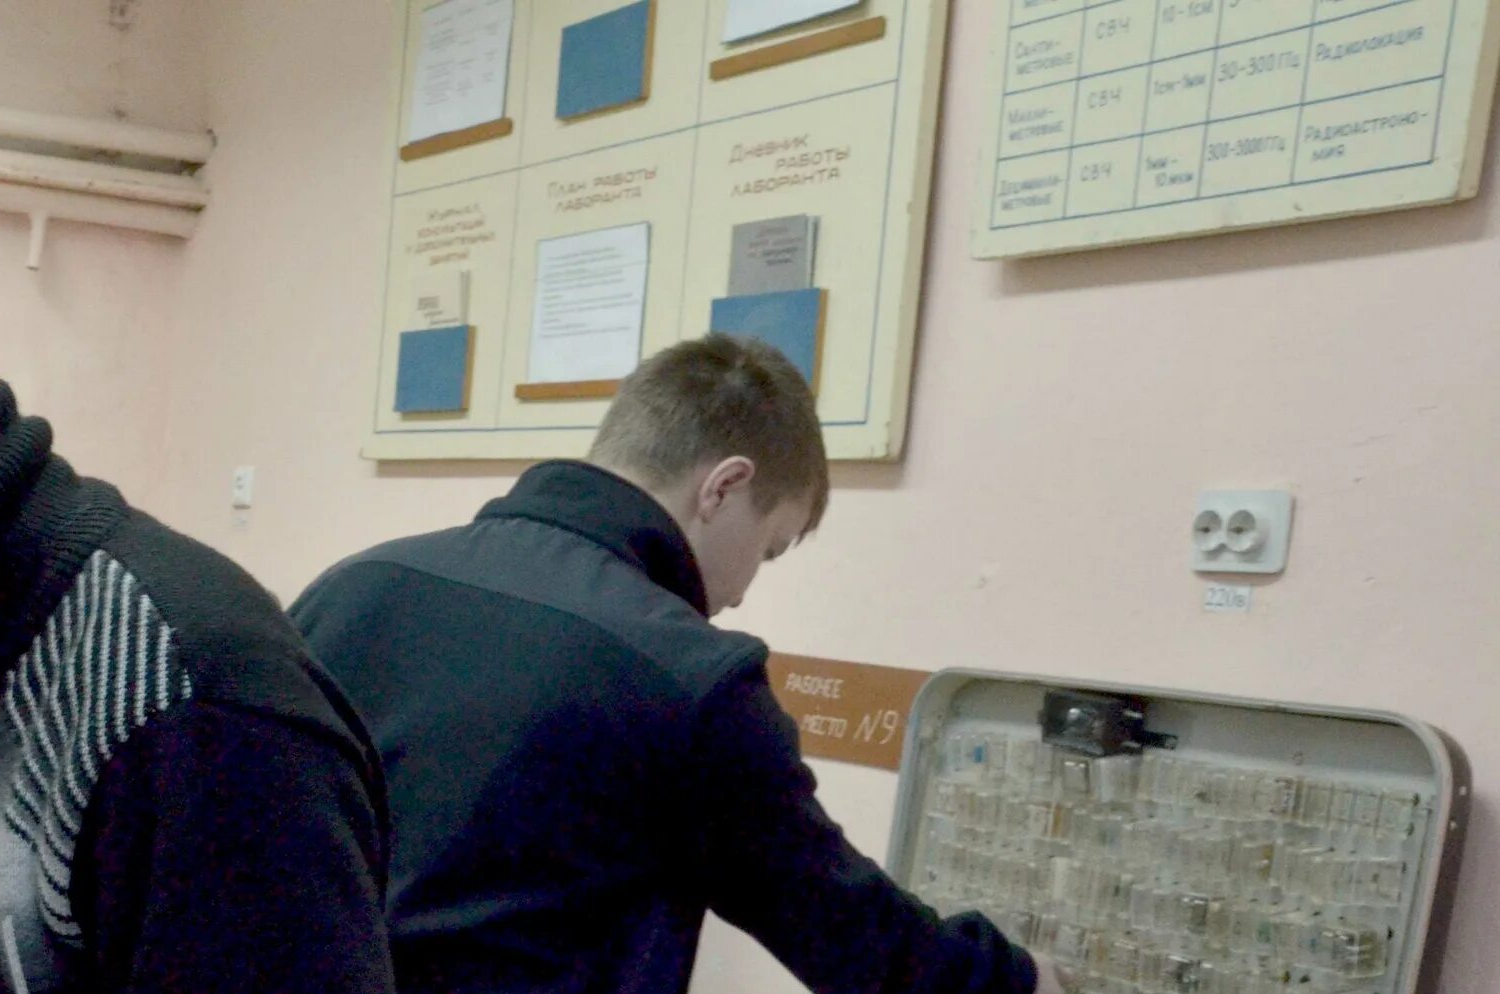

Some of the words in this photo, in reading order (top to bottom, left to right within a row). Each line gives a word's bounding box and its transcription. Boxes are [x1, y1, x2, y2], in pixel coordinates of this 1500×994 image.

[1096, 17, 1131, 40] СВЧ
[1087, 86, 1122, 109] СВЧ
[775, 144, 851, 170] РАБОТЫ
[730, 166, 840, 197] ЛАБОРАНТА
[1080, 161, 1112, 182] СВЧ
[783, 672, 845, 699] РАБОЧЕЕ
[801, 713, 848, 738] МЕСТО
